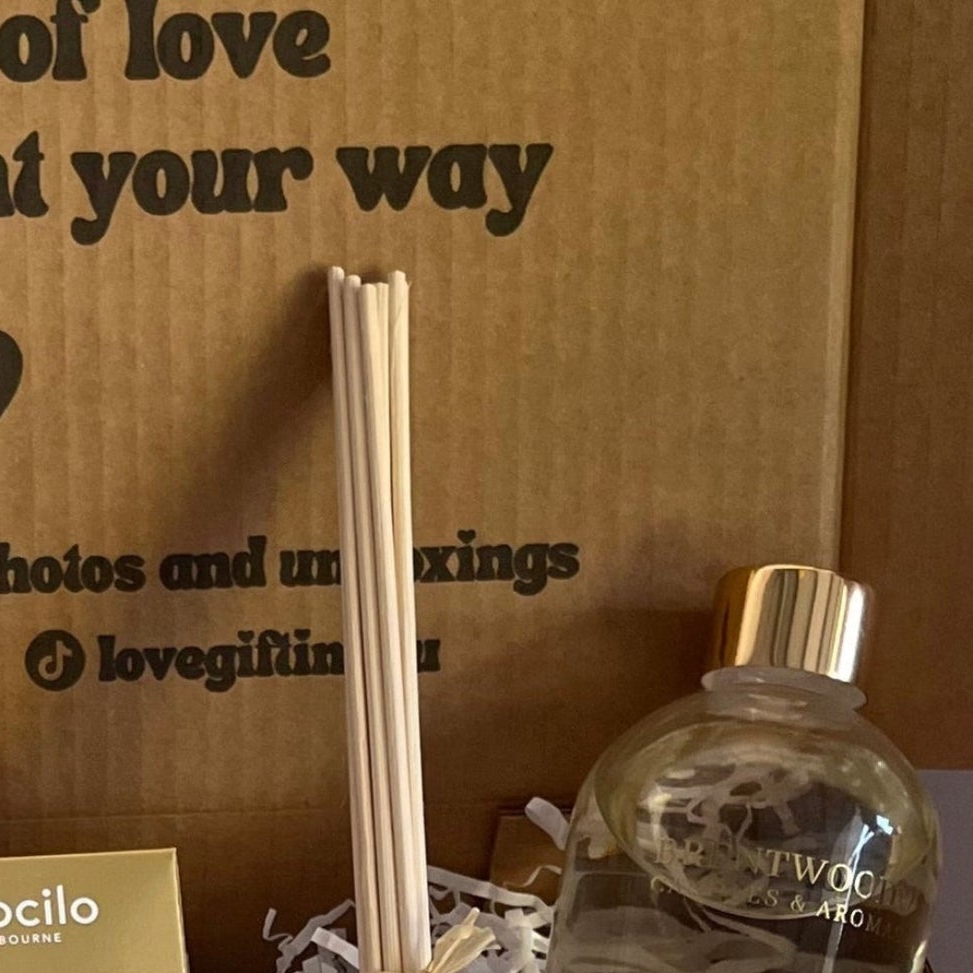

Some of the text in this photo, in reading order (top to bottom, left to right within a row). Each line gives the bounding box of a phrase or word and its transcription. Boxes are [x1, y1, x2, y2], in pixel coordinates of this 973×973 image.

[124, 0, 331, 80] love
[71, 147, 313, 245] your
[336, 144, 553, 236] way
[159, 535, 266, 590] and
[280, 530, 580, 596] unxings
[97, 629, 441, 693] lovegiftinu
